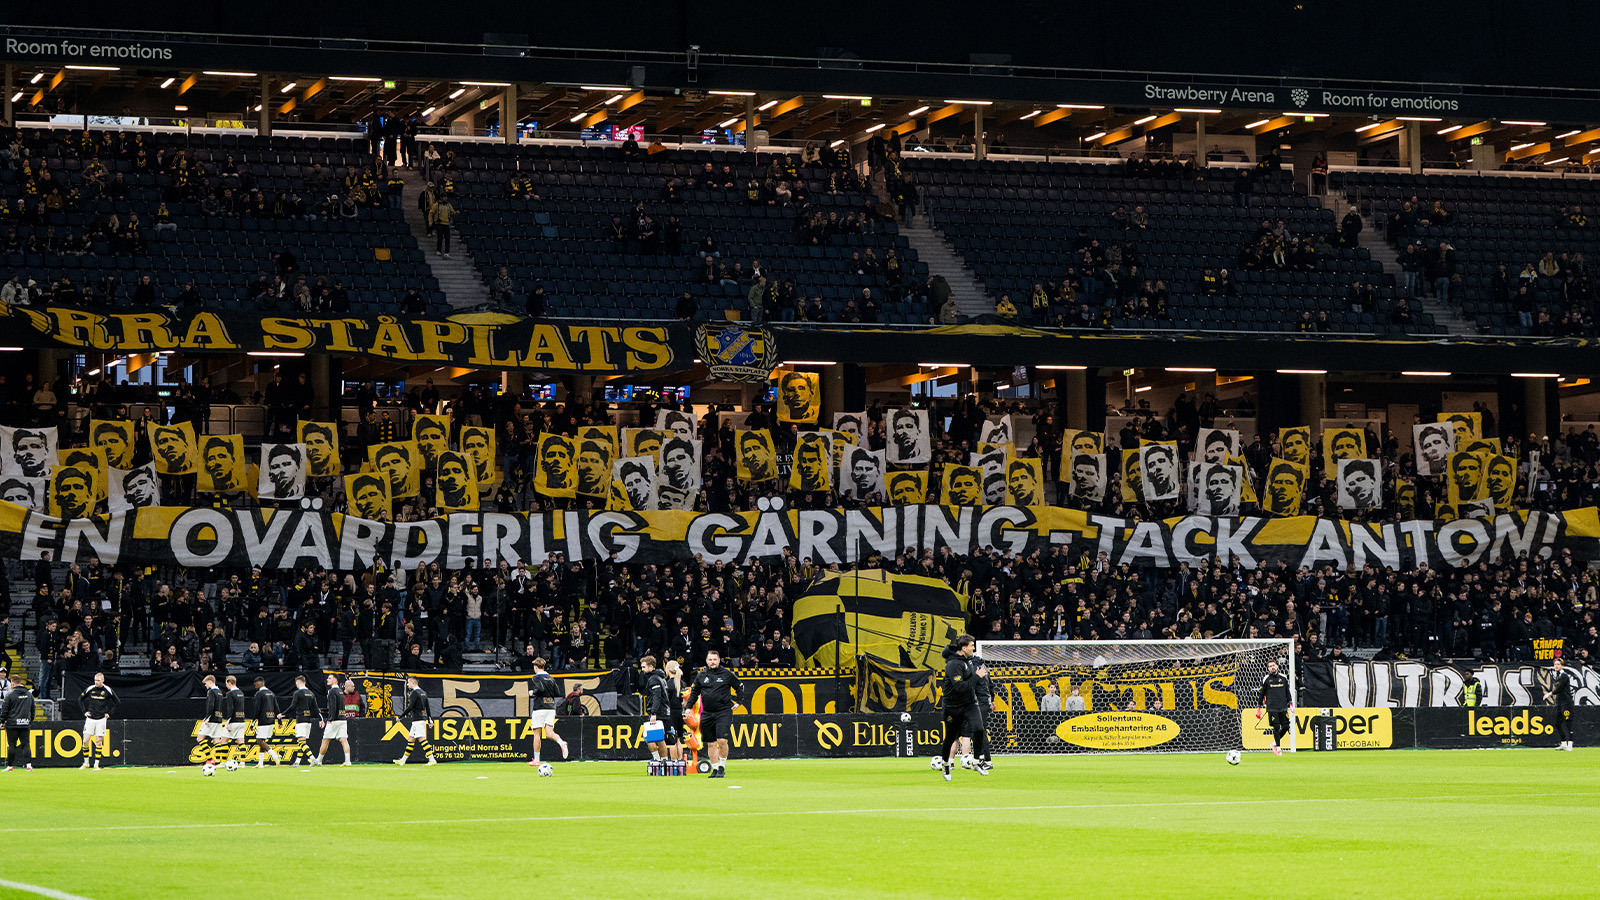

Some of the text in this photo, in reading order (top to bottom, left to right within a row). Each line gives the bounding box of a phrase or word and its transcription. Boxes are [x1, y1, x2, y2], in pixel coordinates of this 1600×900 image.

[6, 38, 173, 60] Room for emotions
[1145, 84, 1275, 104] Strawberry Arena
[1322, 91, 1459, 111] Room for emotions
[261, 315, 676, 371] STÅPLATS
[20, 510, 127, 565] EN
[170, 497, 641, 570] OVÄRDERLIG
[687, 496, 1030, 566] GÄRNING
[1091, 514, 1261, 570] TACK
[1298, 510, 1560, 571] ANTON!
[1533, 637, 1564, 650] KÄMPA
[1334, 661, 1534, 707] ULTRAS
[425, 720, 498, 741] ISAB
[1295, 709, 1379, 735] wber
[0, 729, 121, 758] TION.
[430, 744, 457, 753] junger
[500, 743, 513, 752] Stå
[905, 729, 914, 756] SELECT
[1325, 724, 1333, 750] SELECT
